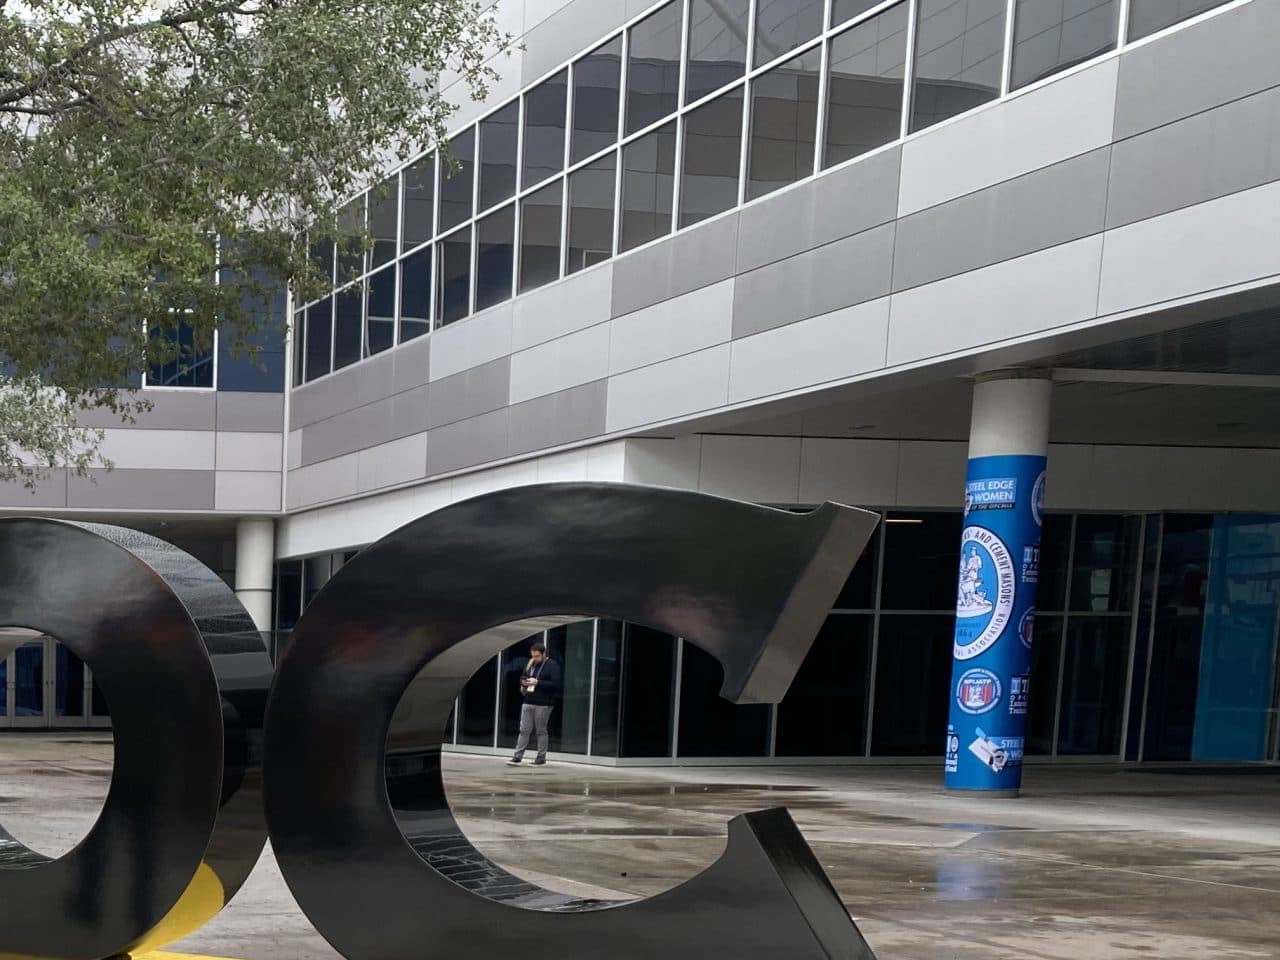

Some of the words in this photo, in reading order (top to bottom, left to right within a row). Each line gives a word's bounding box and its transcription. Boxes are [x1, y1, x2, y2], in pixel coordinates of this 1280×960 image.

[988, 480, 1015, 490] EDGE
[974, 491, 1013, 502] WOMEN
[975, 531, 993, 544] AND
[989, 542, 1011, 570] CEMENT
